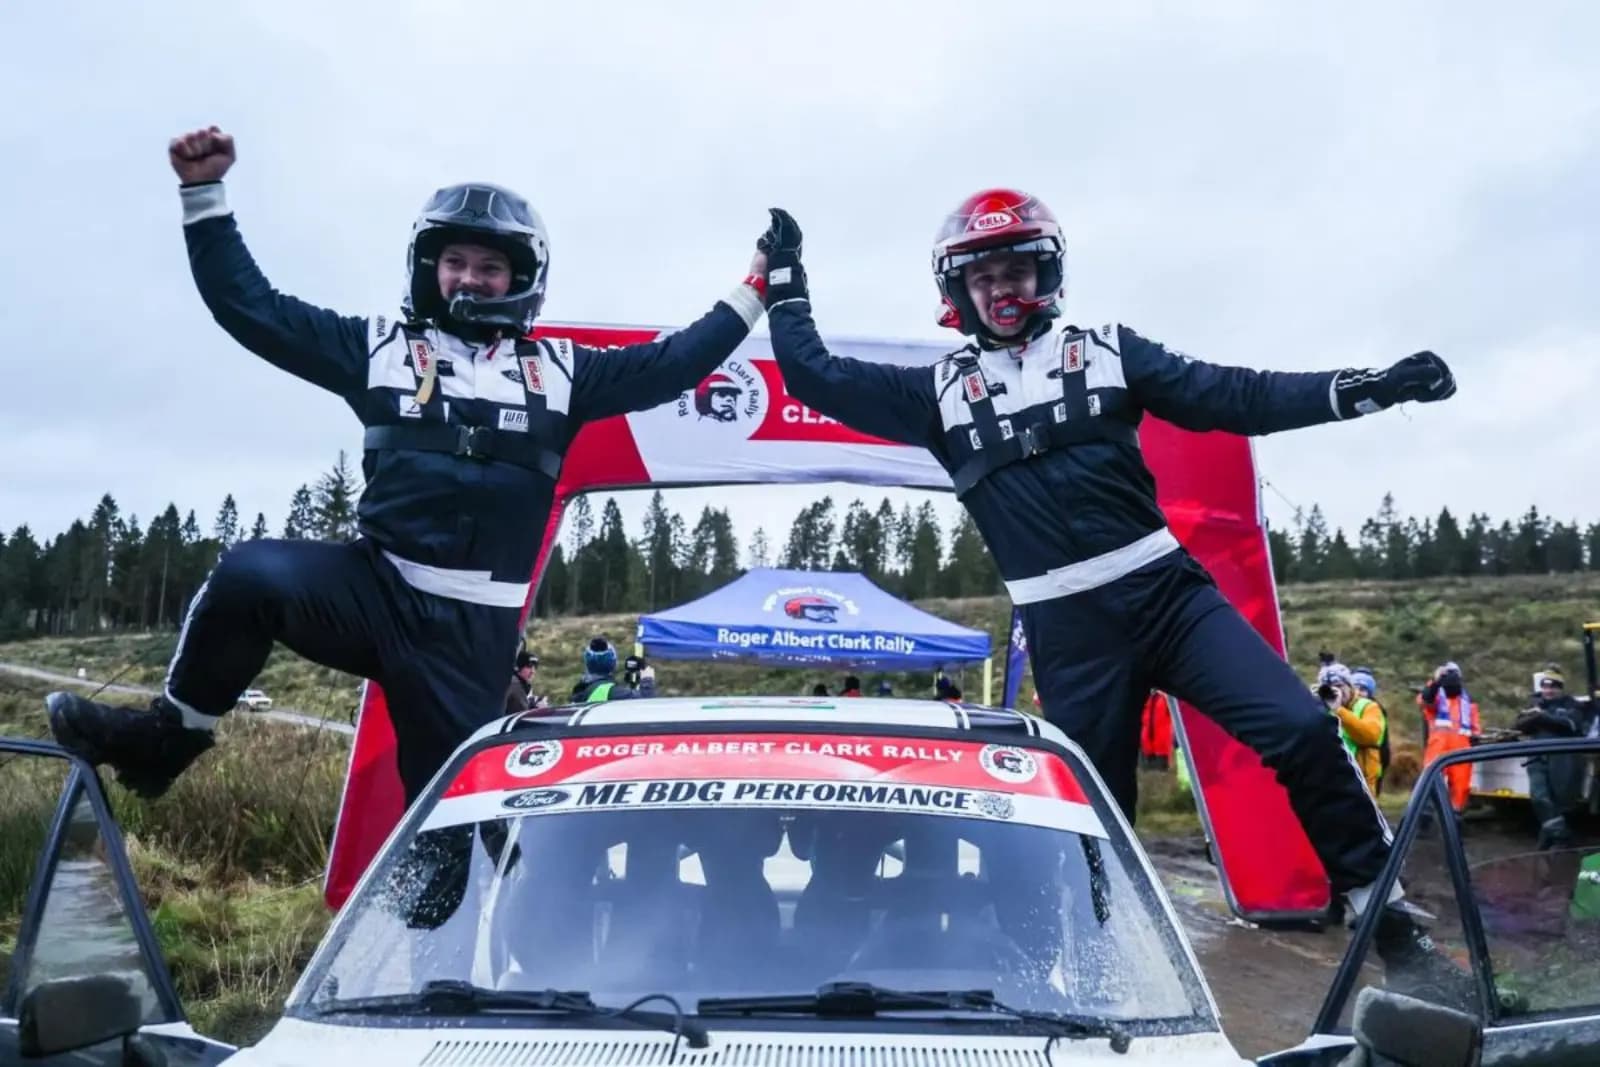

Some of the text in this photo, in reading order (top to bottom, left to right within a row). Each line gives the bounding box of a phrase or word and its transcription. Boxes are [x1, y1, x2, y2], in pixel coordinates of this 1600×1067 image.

[979, 215, 1006, 226] BELL
[677, 391, 690, 417] Rog
[728, 361, 756, 388] Clark
[743, 388, 761, 419] Rally
[717, 629, 916, 655] Roger Albert Clark Rally
[576, 743, 665, 759] ROGER
[672, 742, 777, 757] ALBERT
[783, 742, 873, 758] CLARK
[882, 745, 964, 763] RALLY
[514, 791, 558, 808] Ford
[576, 781, 972, 810] ME BDG PERFORMANCE
